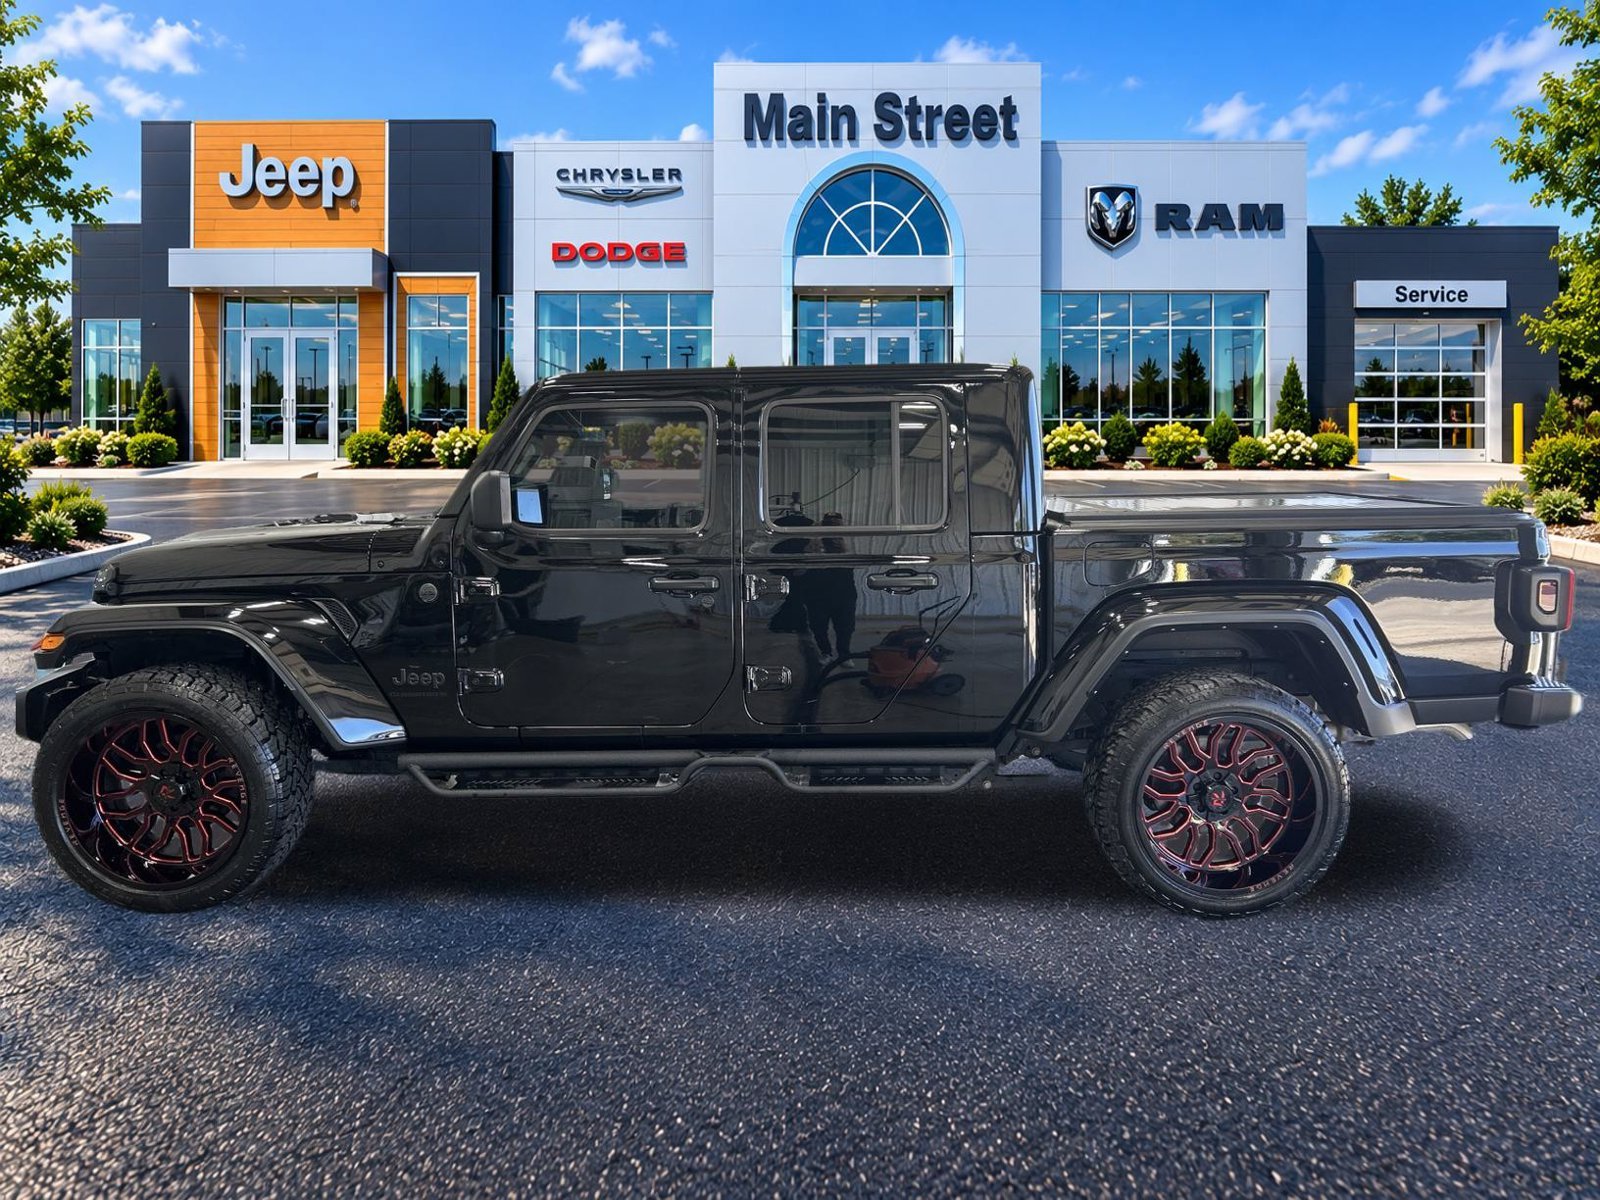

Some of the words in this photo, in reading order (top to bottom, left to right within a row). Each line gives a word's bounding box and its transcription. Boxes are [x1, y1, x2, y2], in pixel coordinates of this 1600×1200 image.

[743, 93, 857, 141] Main
[873, 92, 1017, 141] Street
[219, 143, 355, 208] Jeep
[556, 168, 683, 181] CHRYSLER
[1154, 203, 1284, 231] RAM
[551, 242, 686, 262] DODGE
[1395, 285, 1468, 303] Service
[391, 668, 446, 689] Jeep
